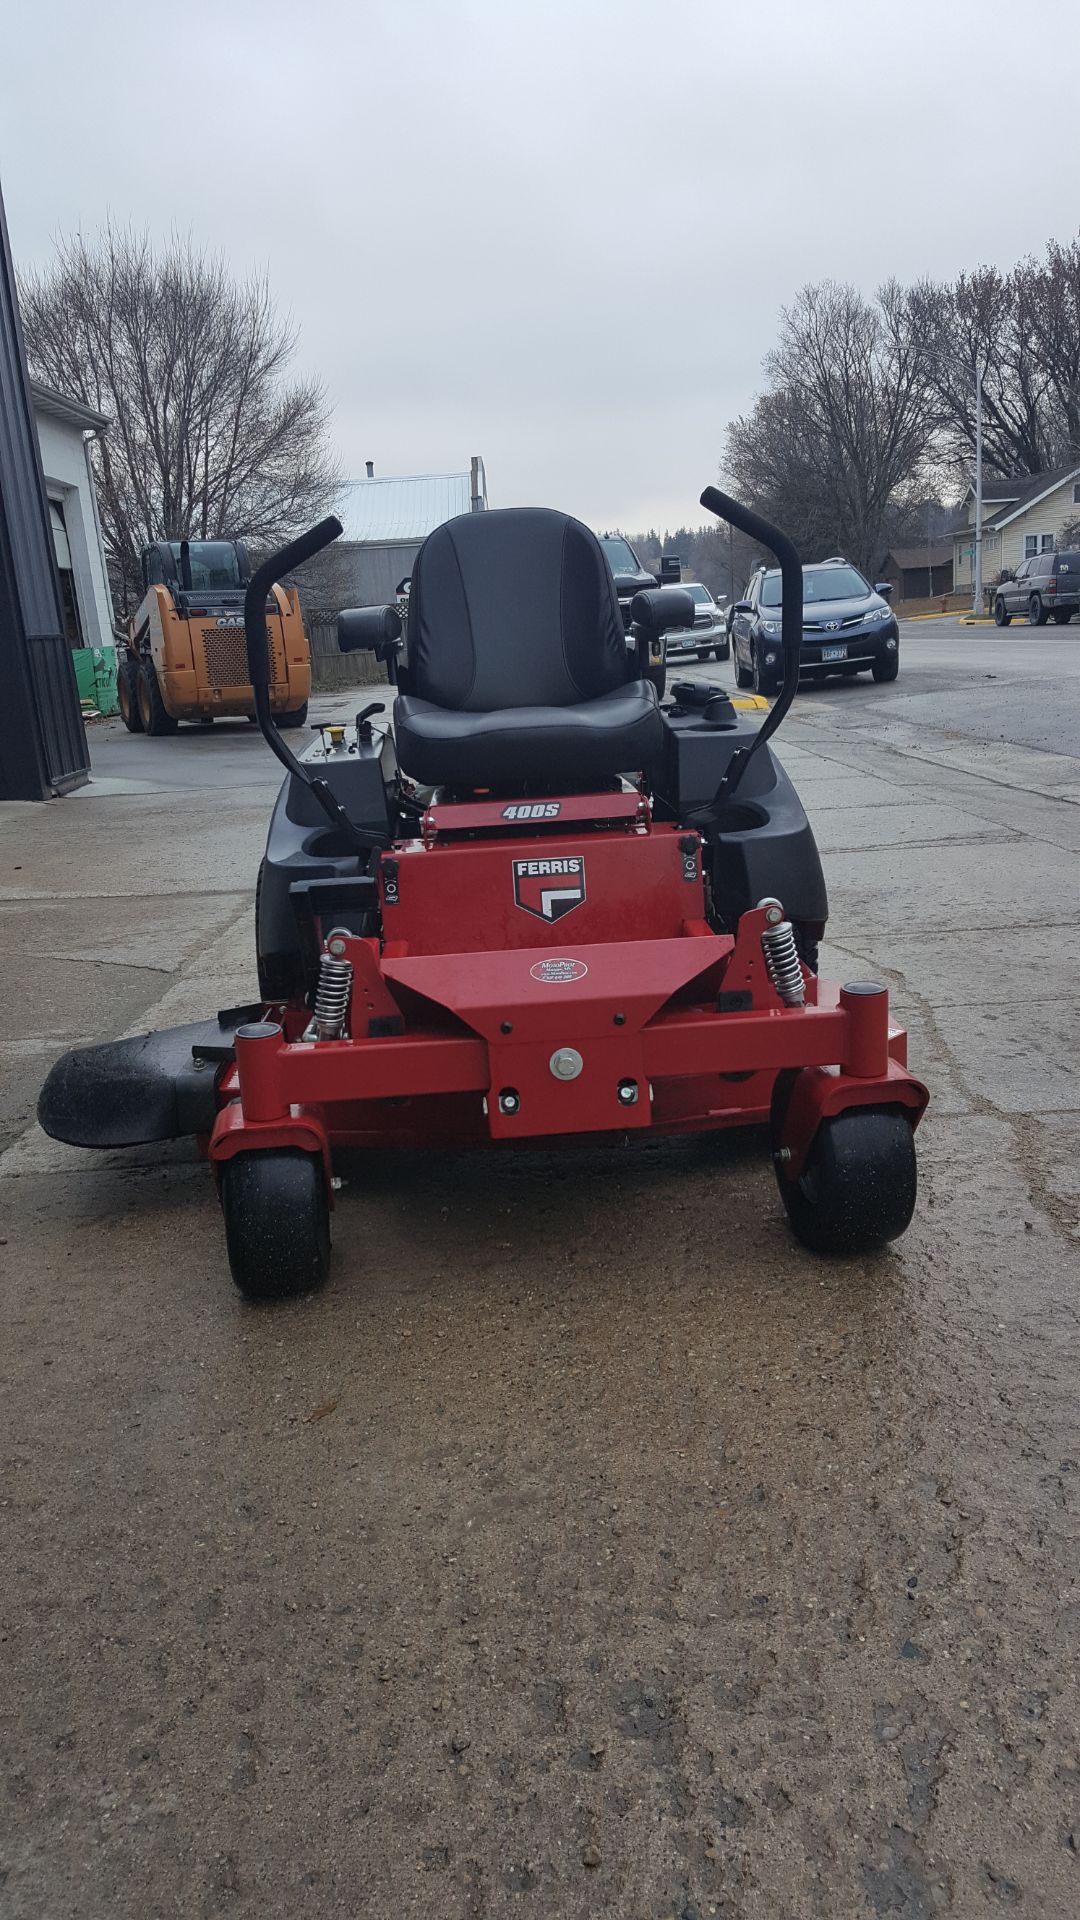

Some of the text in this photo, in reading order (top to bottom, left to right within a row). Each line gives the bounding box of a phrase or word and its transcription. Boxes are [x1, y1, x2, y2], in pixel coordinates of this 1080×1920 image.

[216, 617, 245, 626] CAS
[502, 803, 560, 819] 400S
[517, 859, 580, 876] FERRIS
